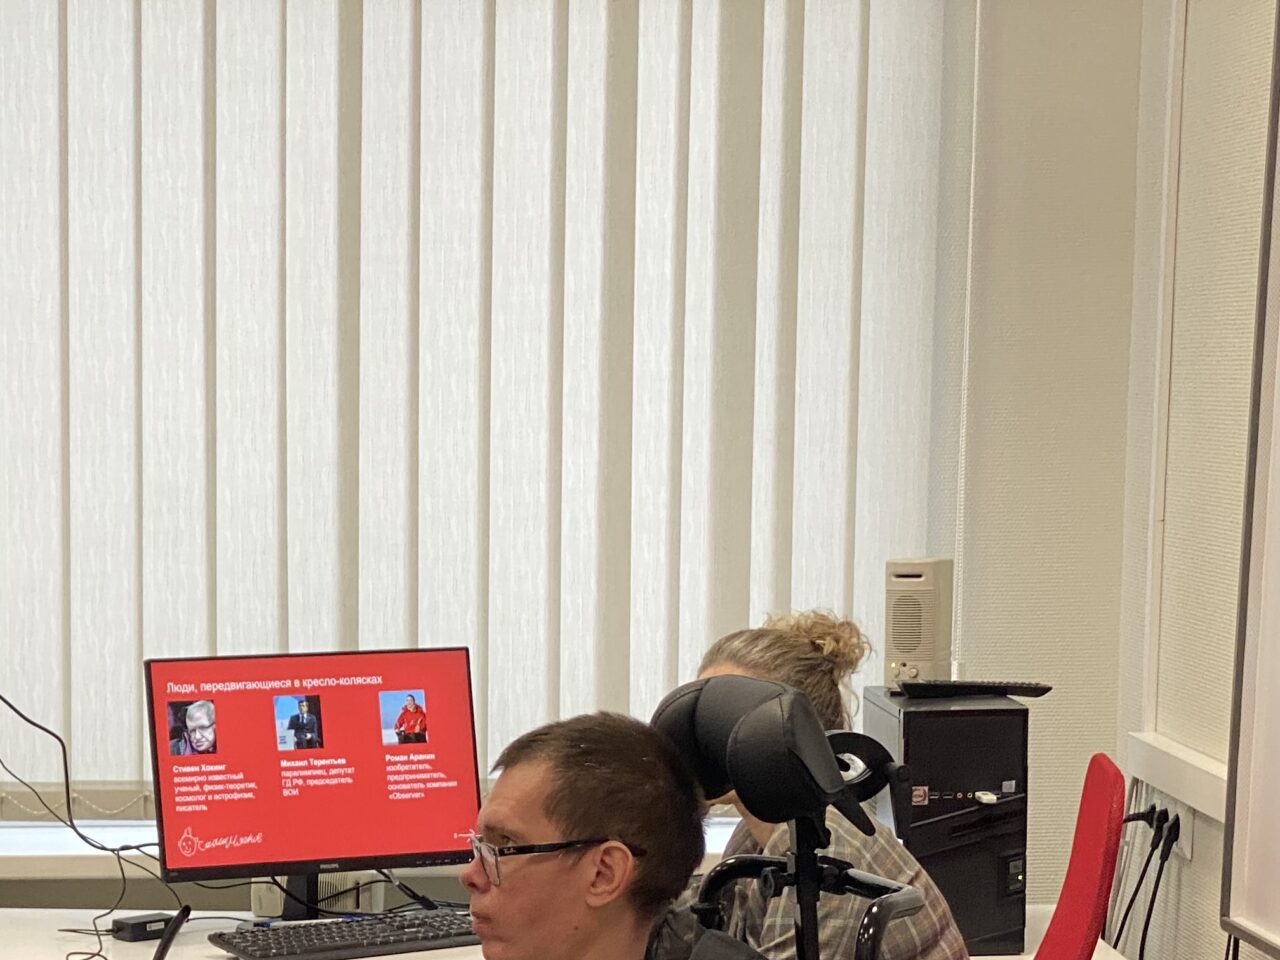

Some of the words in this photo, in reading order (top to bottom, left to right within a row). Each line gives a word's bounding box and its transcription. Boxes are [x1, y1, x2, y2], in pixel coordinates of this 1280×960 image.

[200, 679, 291, 693] передвигающиеся
[294, 680, 300, 688] в
[302, 676, 382, 689] кресло-колясках
[385, 754, 408, 762] Роман
[280, 759, 308, 767] Михаил
[173, 765, 200, 773] Стивен
